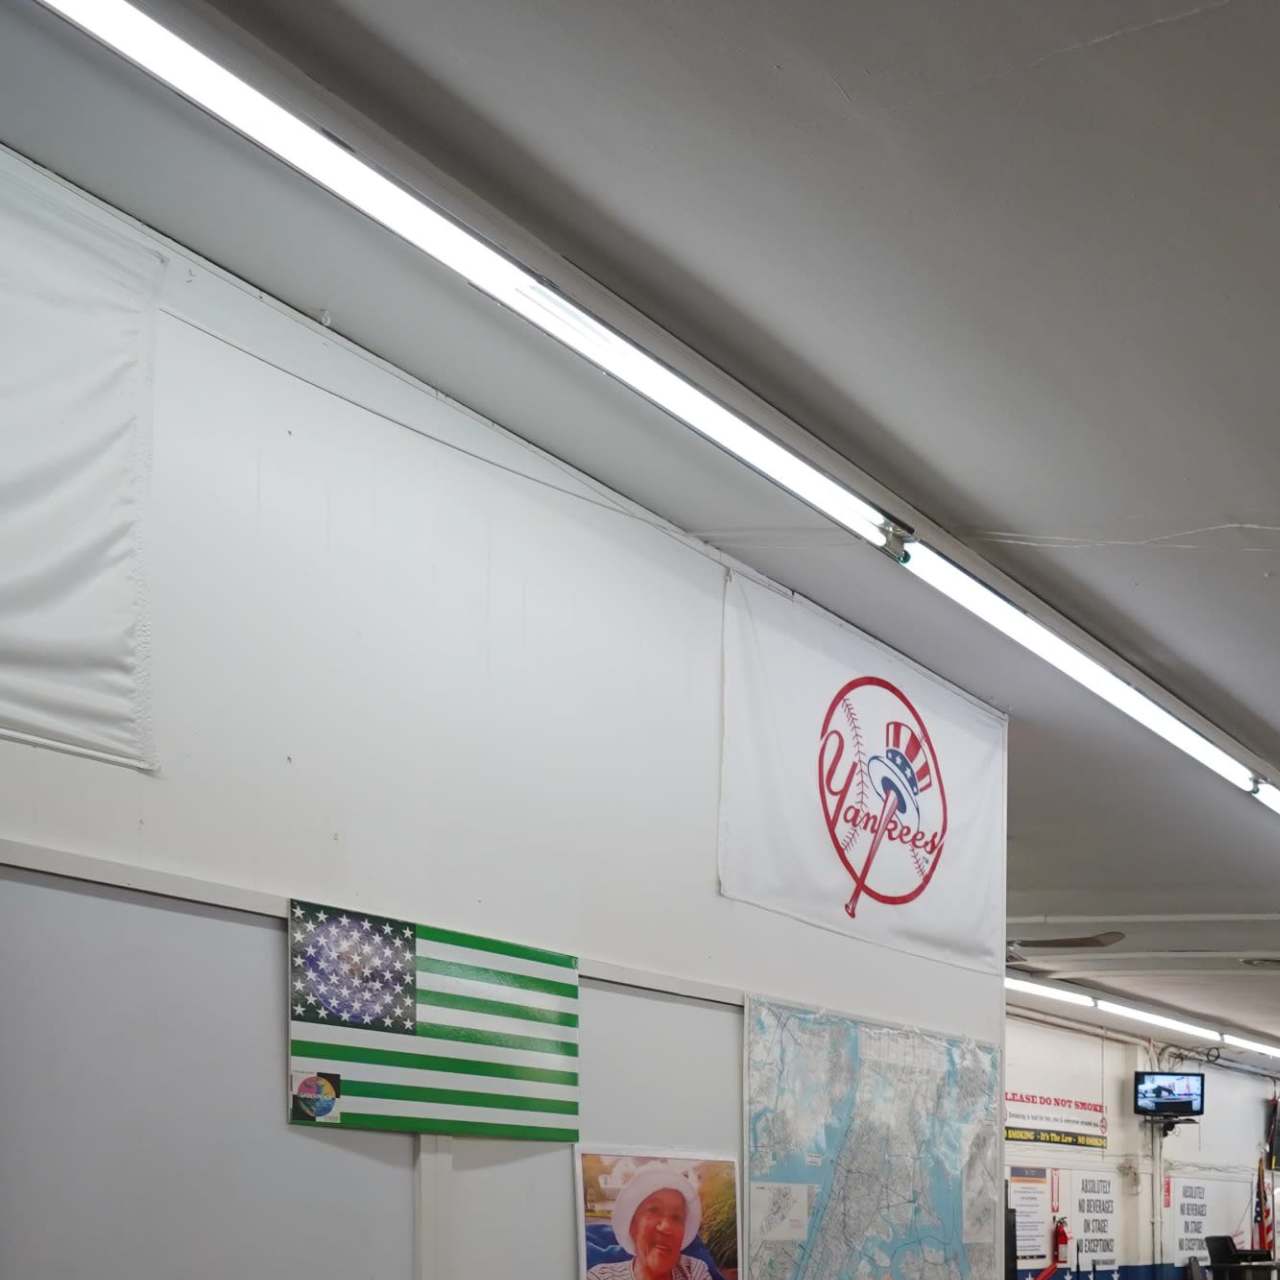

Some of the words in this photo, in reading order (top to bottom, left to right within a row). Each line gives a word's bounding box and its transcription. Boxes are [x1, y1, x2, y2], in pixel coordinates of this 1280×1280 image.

[818, 730, 944, 856] Yankees
[1005, 1092, 1038, 1104] LEASE
[1040, 1097, 1052, 1106] DO
[1054, 1098, 1073, 1109] NOT
[1081, 1179, 1111, 1194] ABSOLUTELY
[1078, 1198, 1086, 1213] NO
[1086, 1199, 1114, 1214] BEVERAGES
